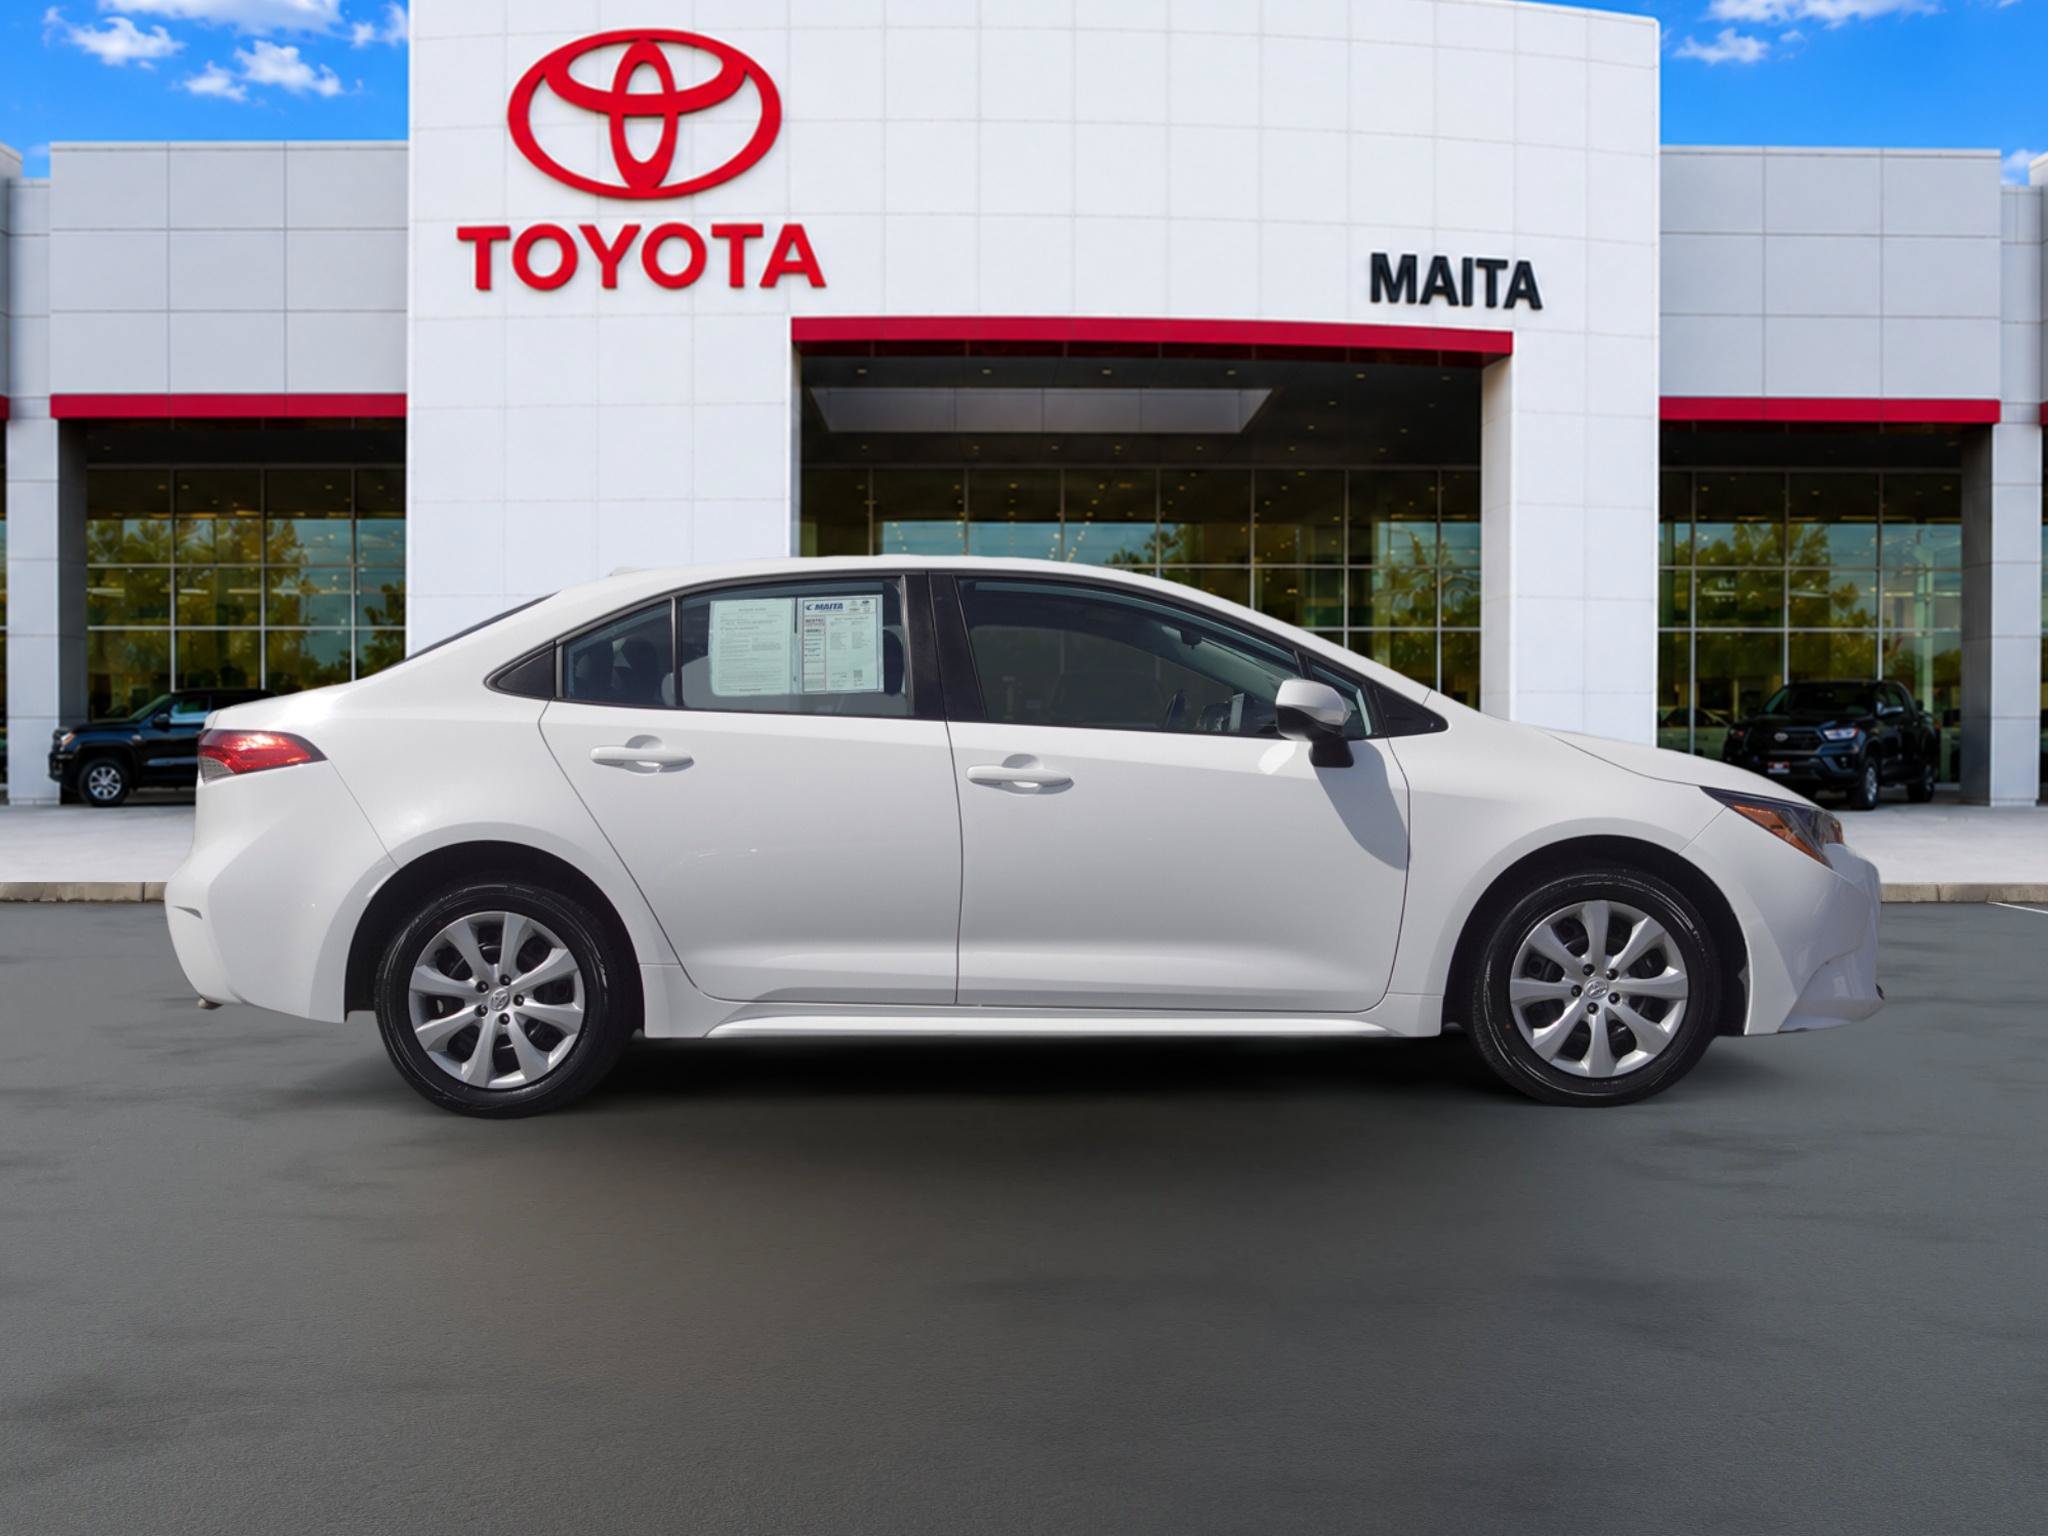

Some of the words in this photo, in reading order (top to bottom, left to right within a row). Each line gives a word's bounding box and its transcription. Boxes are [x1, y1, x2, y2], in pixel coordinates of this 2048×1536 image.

[457, 222, 827, 291] TOYOTA
[1370, 252, 1543, 310] MAITA
[814, 602, 844, 611] MAITA
